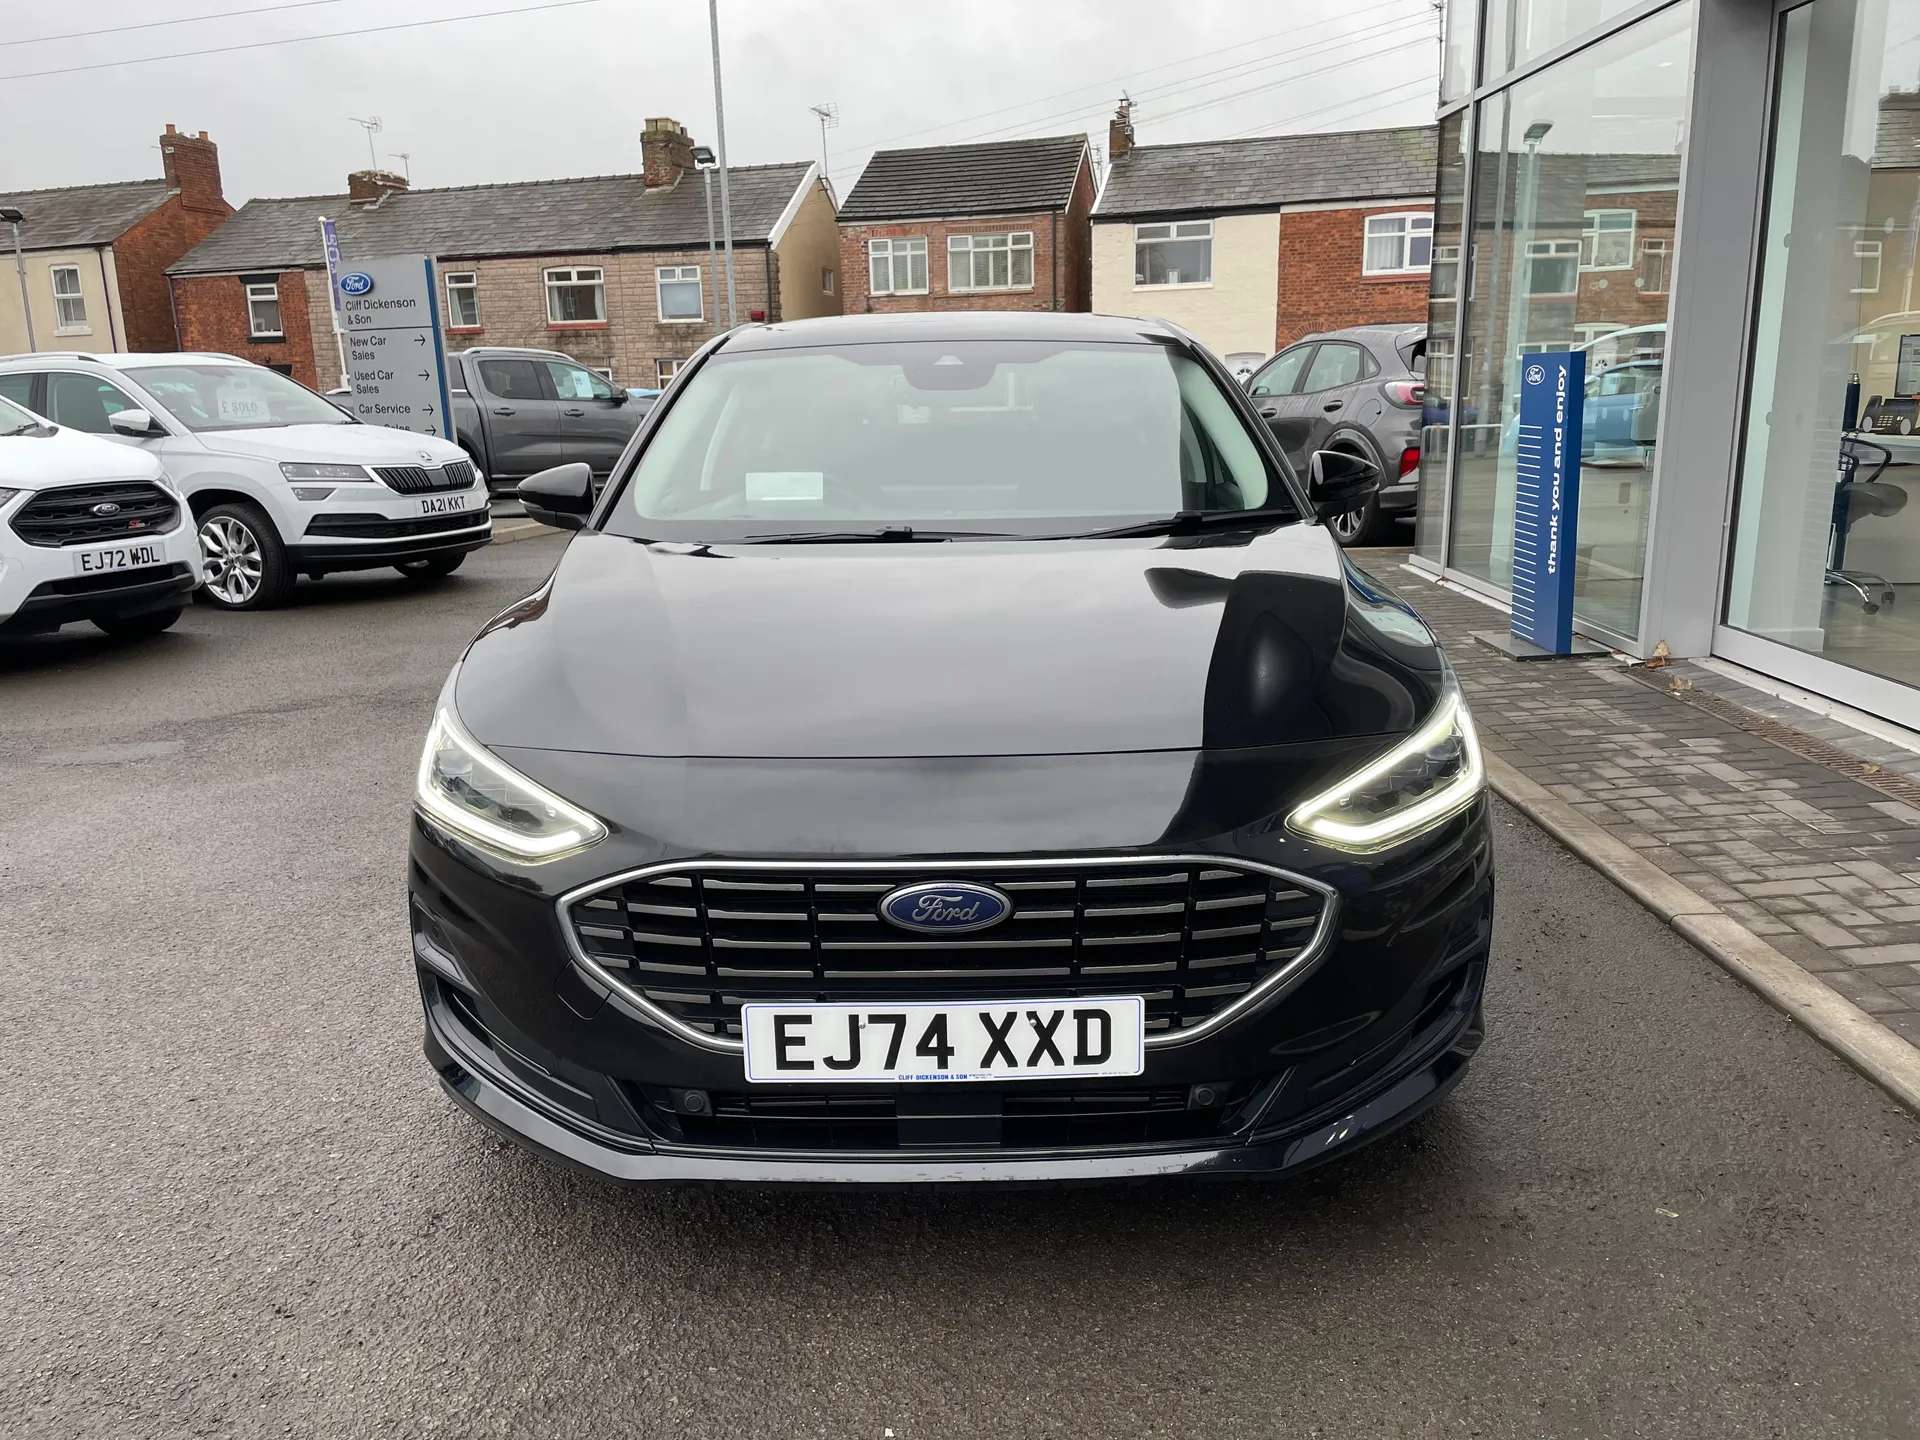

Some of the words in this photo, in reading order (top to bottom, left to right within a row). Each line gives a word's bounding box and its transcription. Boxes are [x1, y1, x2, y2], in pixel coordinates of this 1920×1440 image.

[346, 276, 364, 291] Ford
[346, 300, 361, 311] Cliff
[364, 299, 416, 310] Dickenson
[348, 315, 353, 325] &
[354, 314, 371, 324] Son
[350, 337, 368, 346] New
[370, 336, 386, 346] Car
[352, 350, 375, 360] Sales
[354, 370, 375, 380] Used
[377, 370, 394, 380] Car
[356, 384, 379, 394] Sales
[1556, 365, 1567, 424] enjoy
[359, 404, 373, 414] Car
[375, 404, 411, 414] Service
[1553, 428, 1562, 468] and
[1551, 475, 1560, 511] you
[422, 498, 447, 513] DA21
[448, 496, 465, 511] KKT
[1547, 514, 1558, 575] thank
[81, 550, 126, 572] EJ72
[130, 546, 160, 565] WDL
[912, 895, 980, 922] Ford
[773, 1013, 955, 1070] EJ74
[978, 1008, 1112, 1068] XXD
